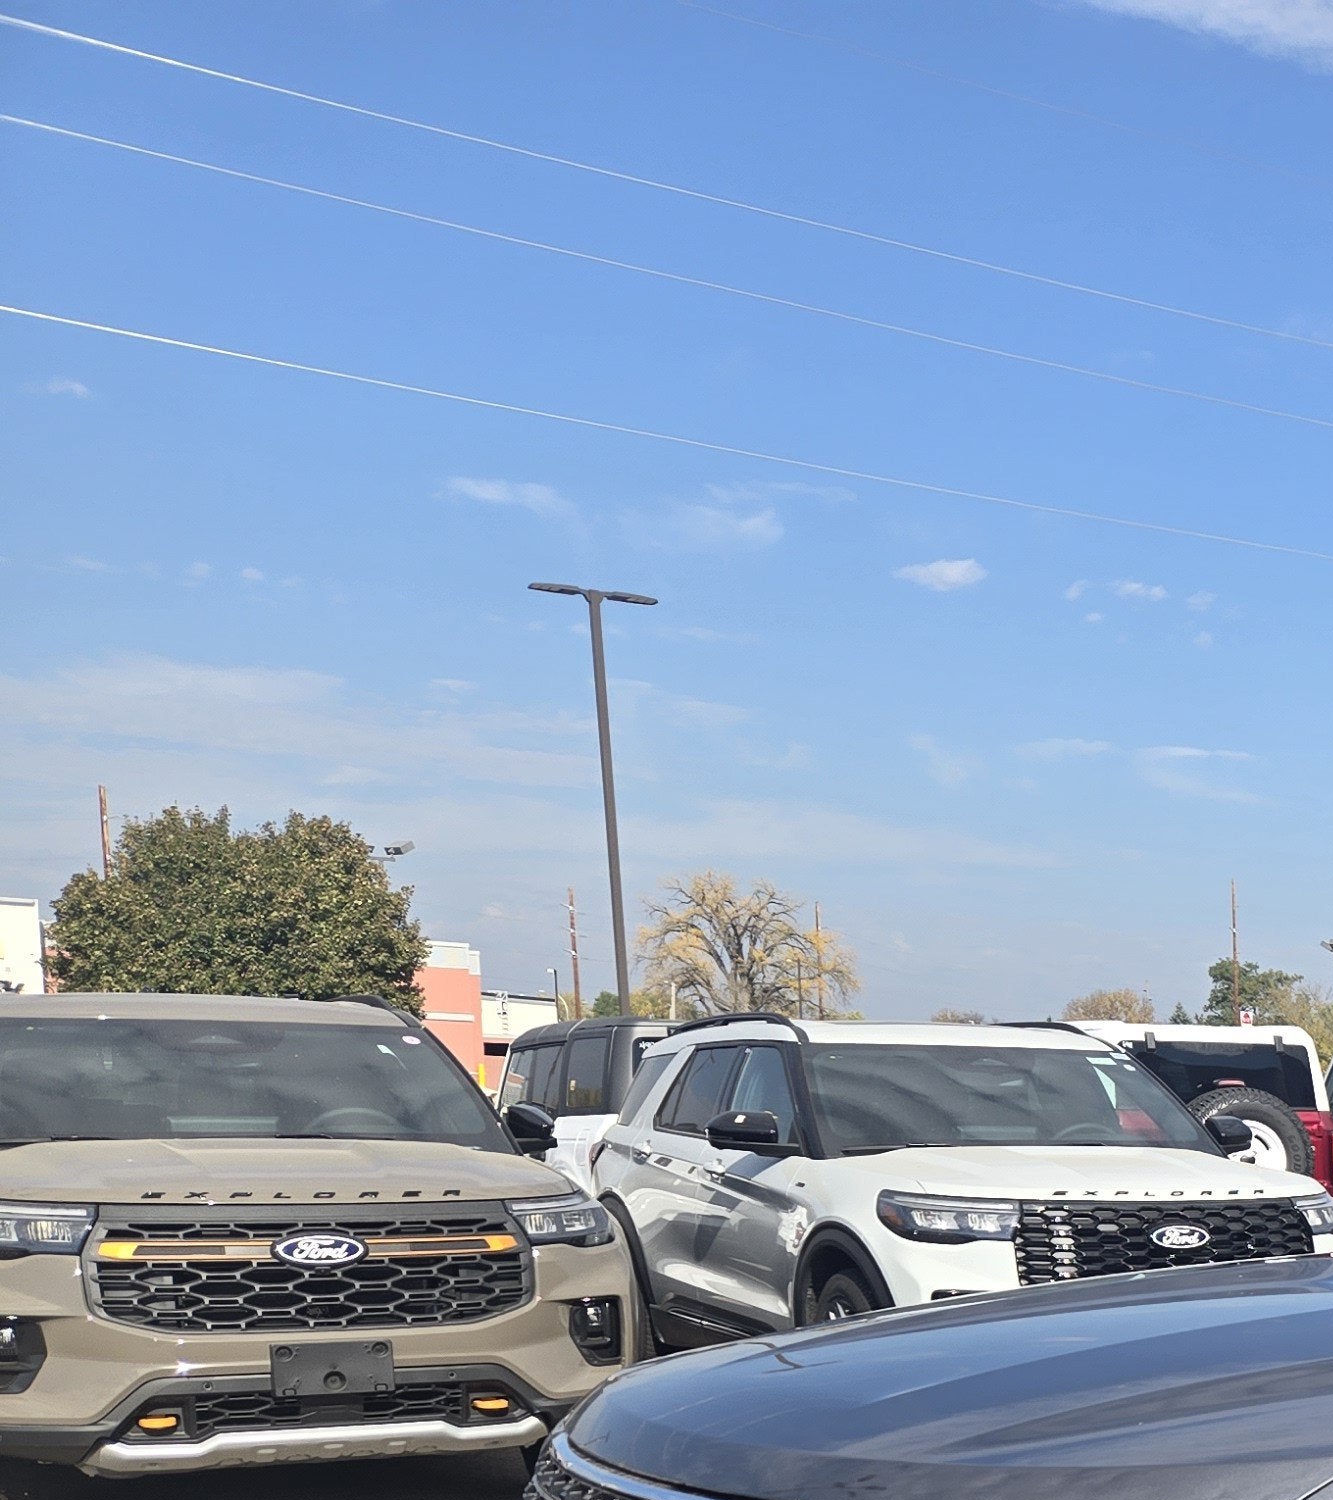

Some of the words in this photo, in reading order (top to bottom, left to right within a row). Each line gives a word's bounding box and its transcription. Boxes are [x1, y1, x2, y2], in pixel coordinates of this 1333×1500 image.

[141, 1190, 461, 1199] EXPLORER
[1052, 1189, 1264, 1197] EXPLORER
[1162, 1228, 1201, 1246] Ford
[293, 1238, 350, 1261] Ford
